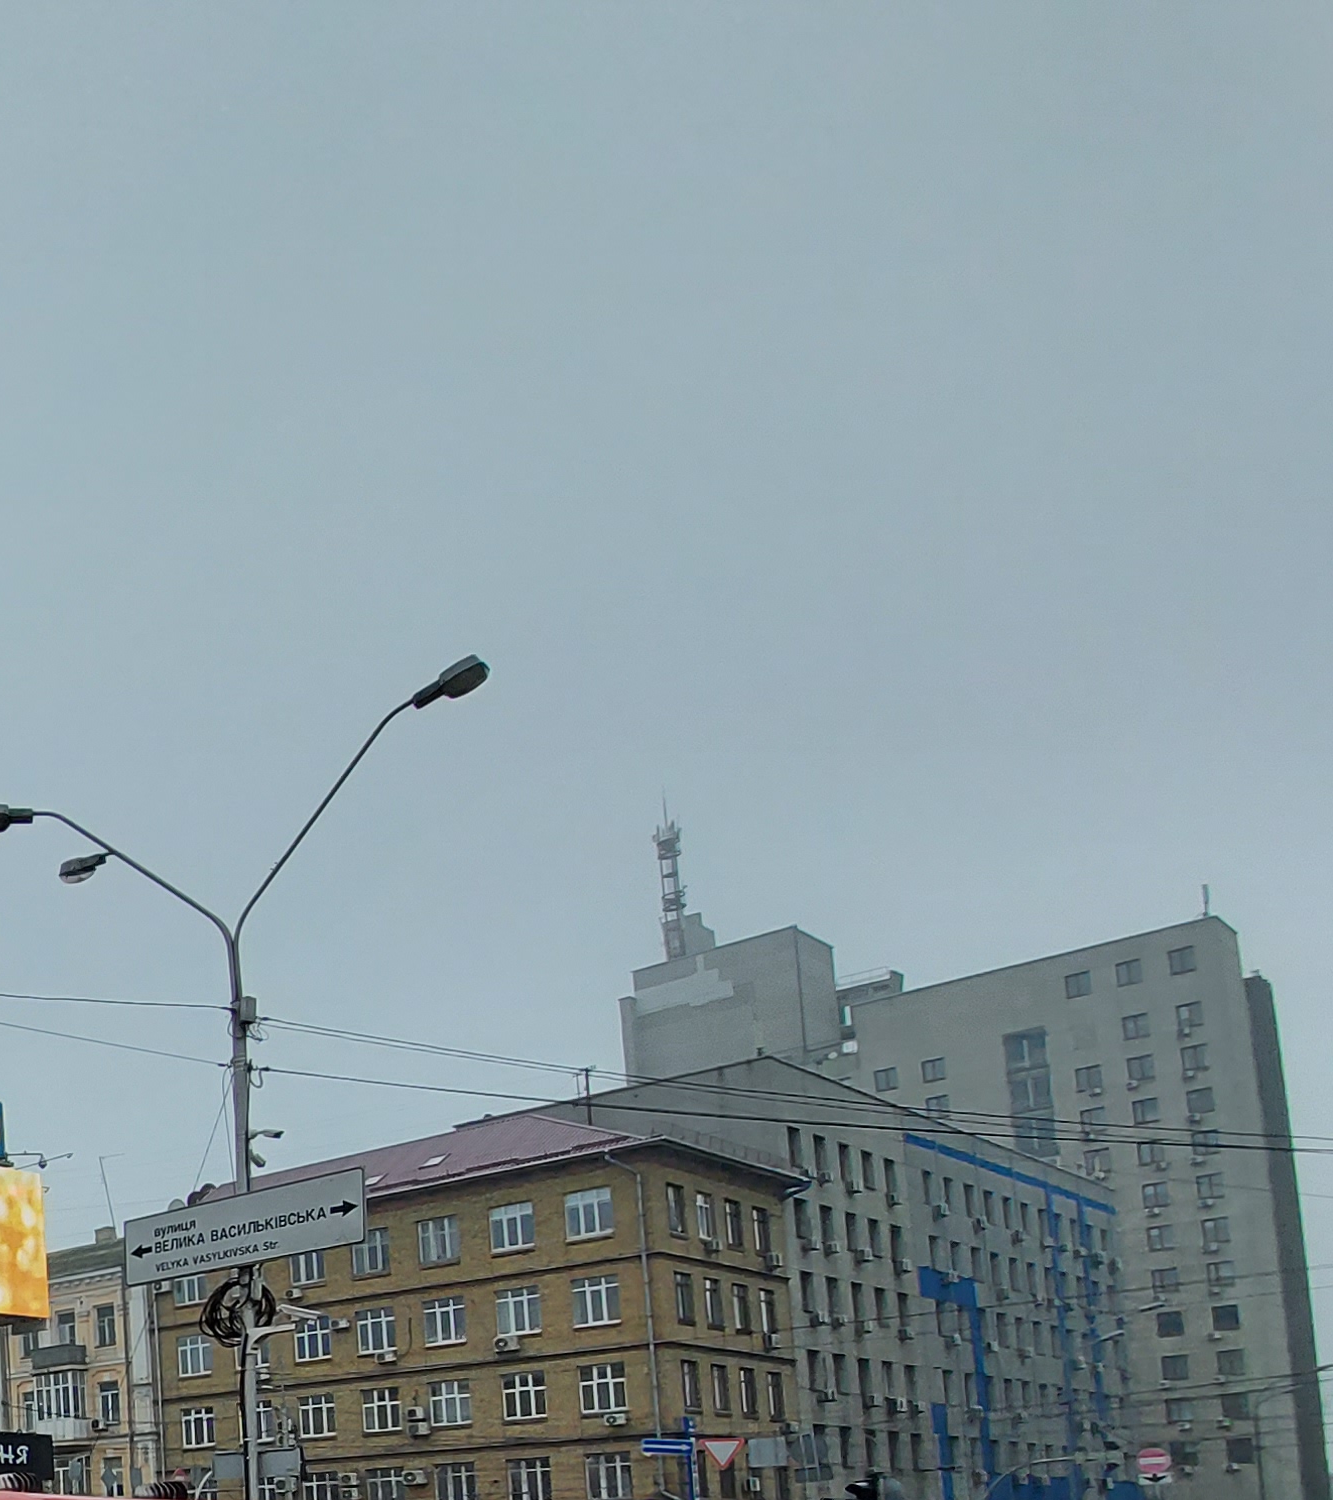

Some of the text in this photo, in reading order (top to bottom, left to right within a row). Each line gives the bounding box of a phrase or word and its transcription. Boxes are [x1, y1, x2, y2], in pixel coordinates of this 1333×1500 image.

[153, 1219, 196, 1238] вулиця
[154, 1206, 327, 1254] ВЕЛИКА ВАСИЛЬКІВСЬКА
[155, 1257, 190, 1273] VELYKA
[192, 1244, 259, 1266] VASYLKIVSKA
